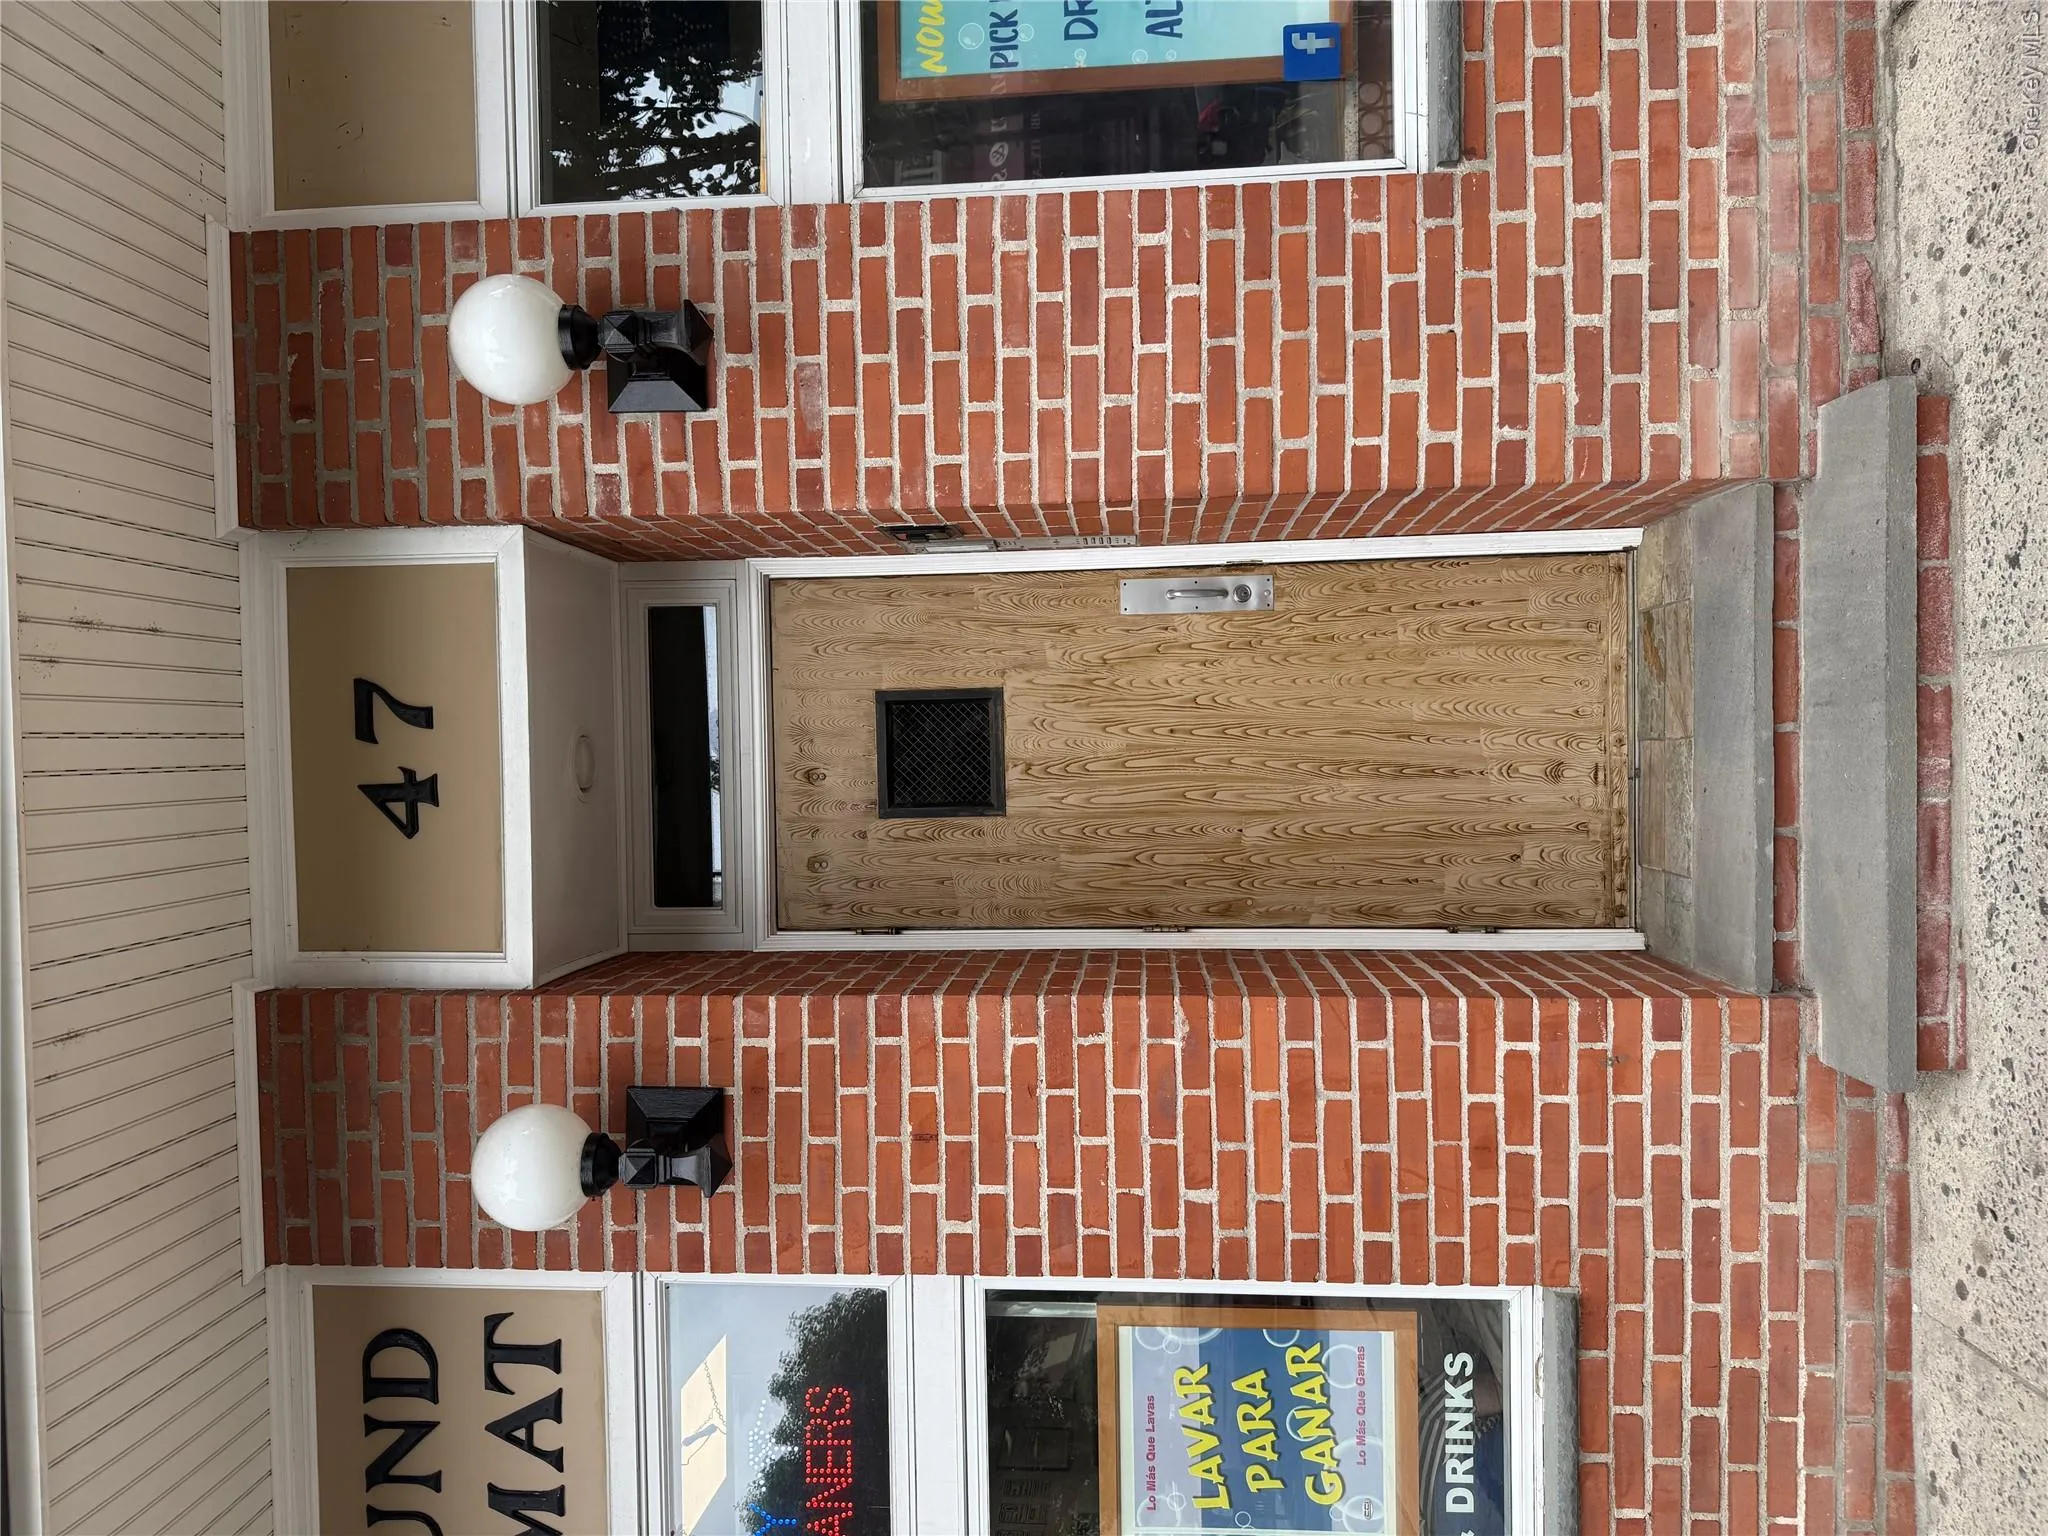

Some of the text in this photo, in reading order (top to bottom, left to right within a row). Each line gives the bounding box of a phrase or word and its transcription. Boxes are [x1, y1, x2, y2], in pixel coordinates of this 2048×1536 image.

[989, 8, 1018, 69] PICK
[1145, 0, 1183, 39] AL
[353, 677, 439, 839] 47
[1144, 1394, 1157, 1511] Lo Más Que Lavas
[1172, 1362, 1231, 1511] LAVAR
[1231, 1368, 1286, 1493] PARA
[1285, 1341, 1345, 1506] GANAR
[1354, 1345, 1367, 1466] Lo Más Que Ganas
[1443, 1351, 1475, 1514] DRINKS
